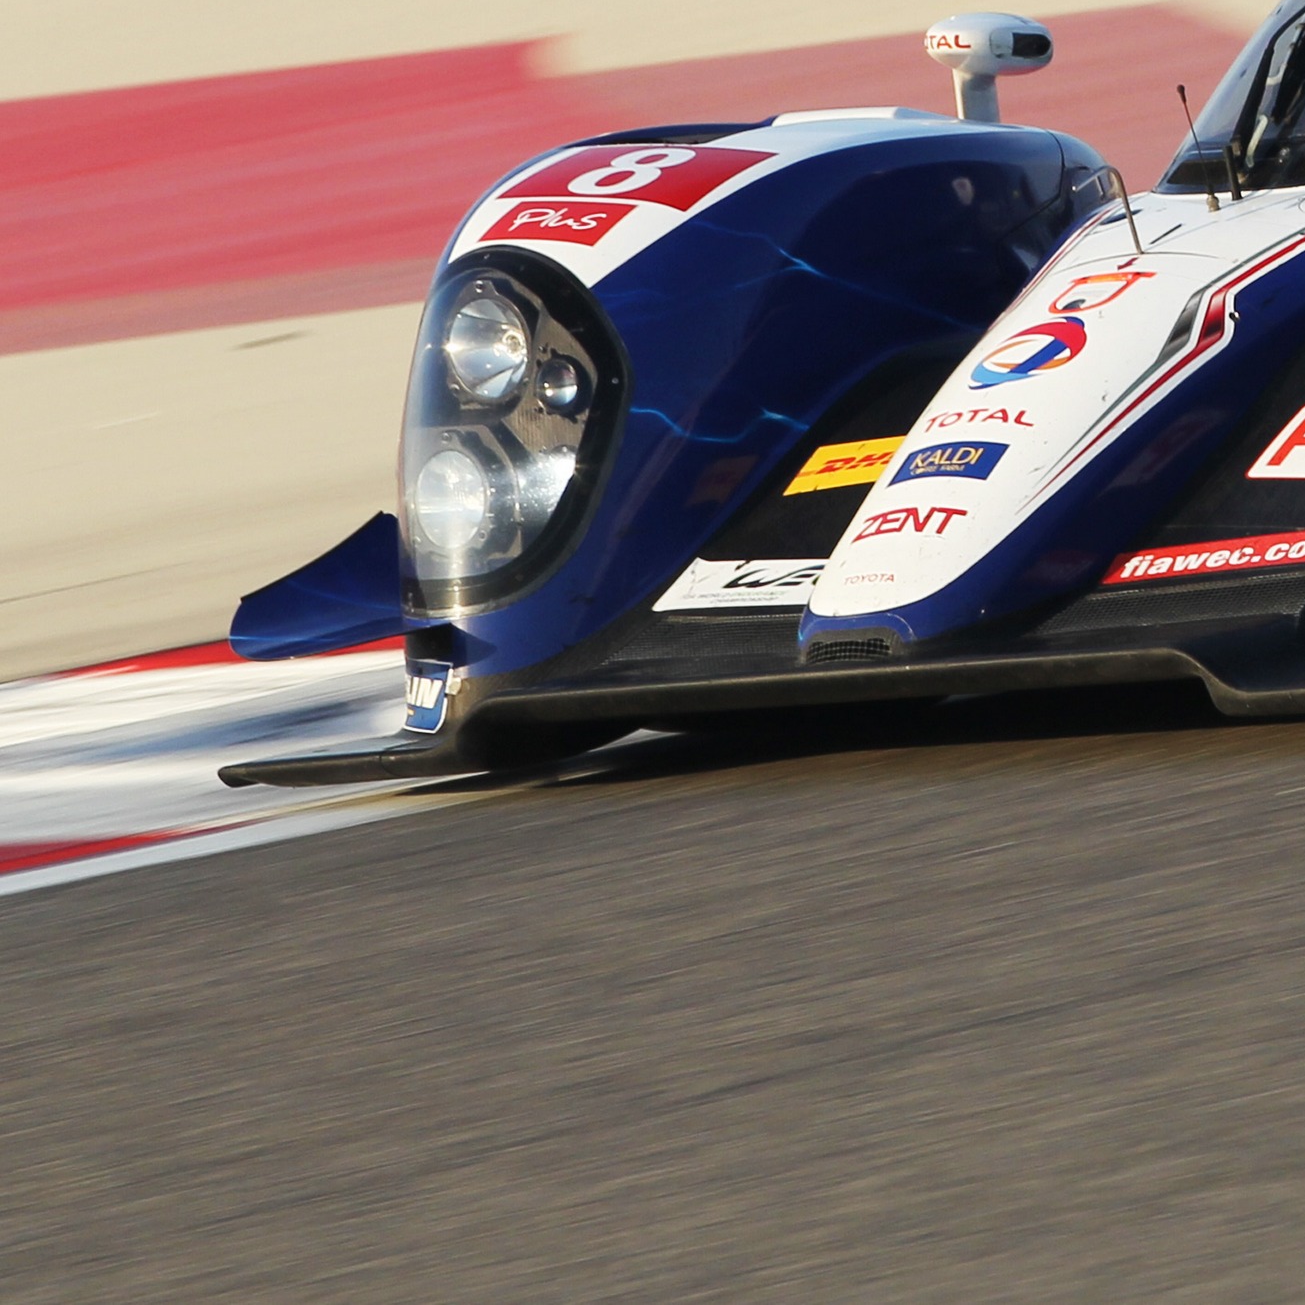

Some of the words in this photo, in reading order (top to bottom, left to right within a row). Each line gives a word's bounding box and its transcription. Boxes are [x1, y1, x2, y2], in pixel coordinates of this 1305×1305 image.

[567, 147, 697, 195] 8
[924, 408, 1035, 434] TOTAL
[909, 446, 985, 470] KALDI
[851, 507, 969, 544] ZENT
[722, 564, 826, 589] WE
[844, 573, 896, 586] TOYOTA
